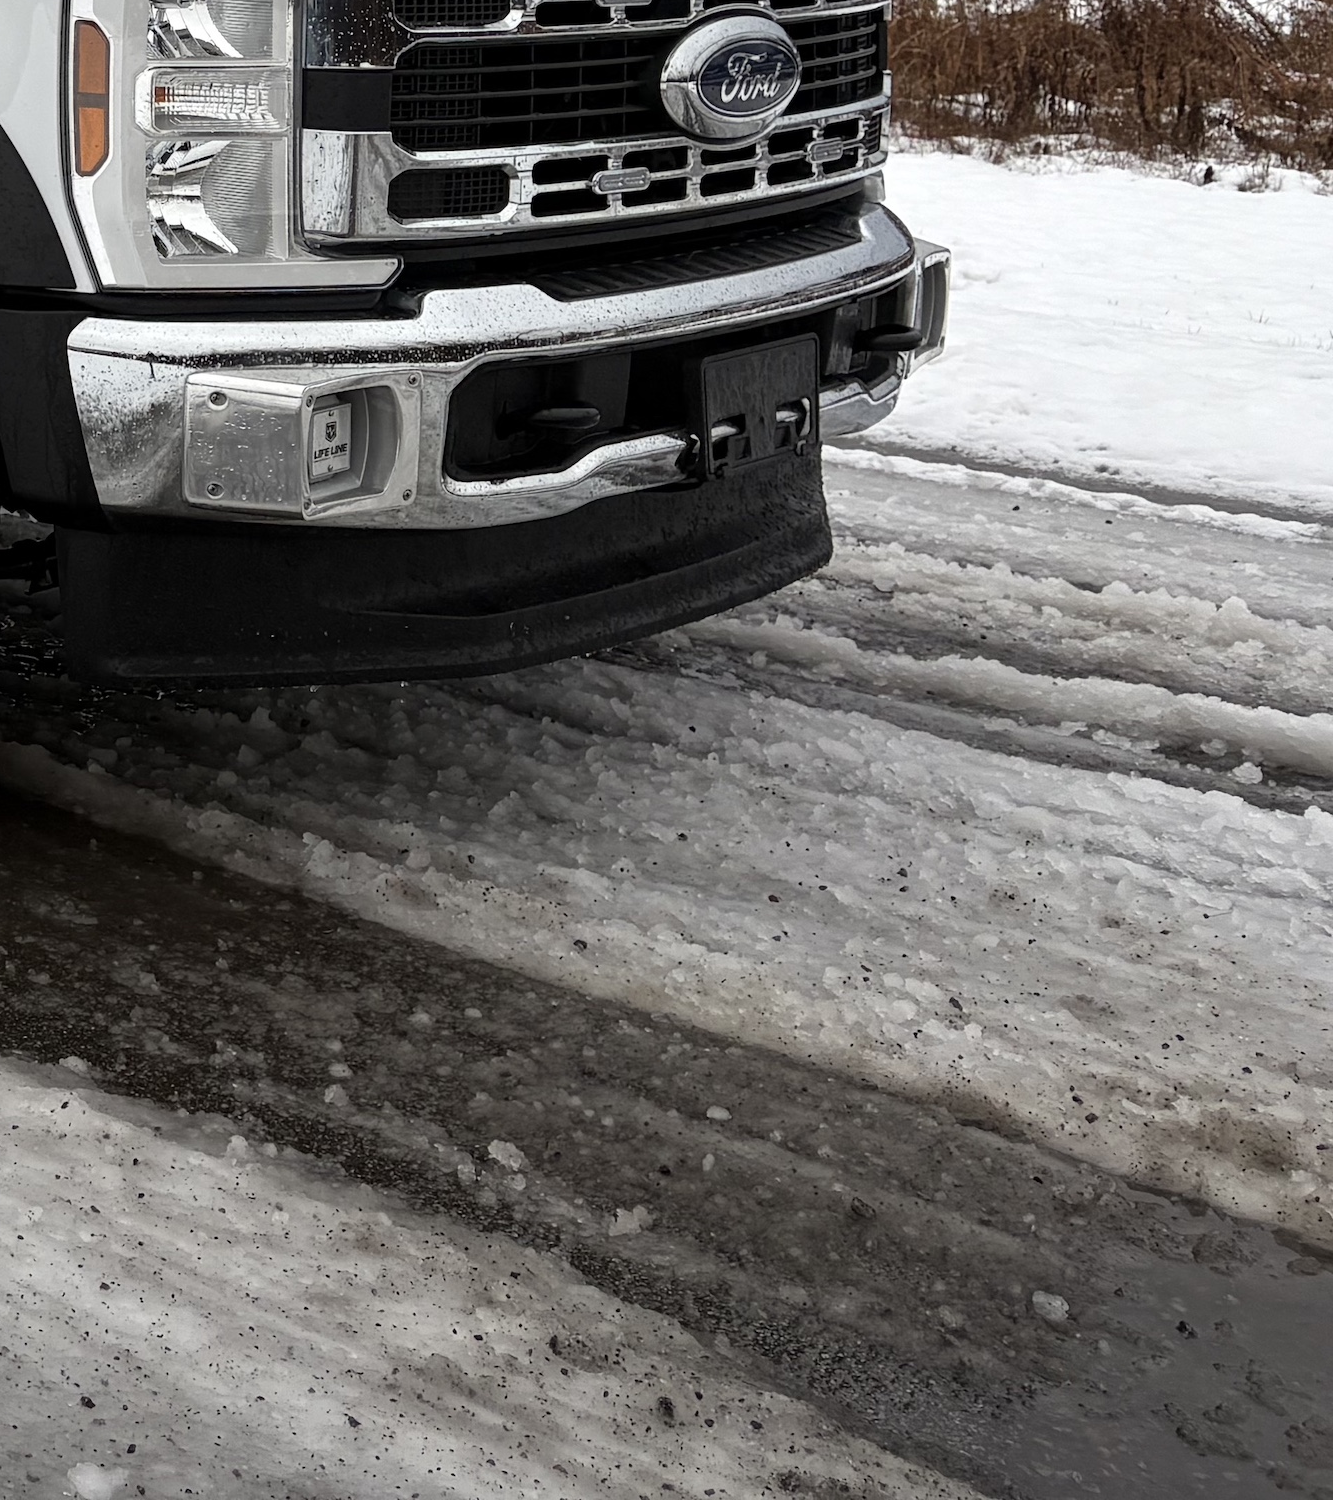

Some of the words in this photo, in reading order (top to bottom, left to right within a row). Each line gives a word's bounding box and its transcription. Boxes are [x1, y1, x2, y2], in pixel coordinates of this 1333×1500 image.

[720, 52, 782, 103] Ford
[314, 447, 330, 459] LIFE
[331, 443, 347, 455] LINE
